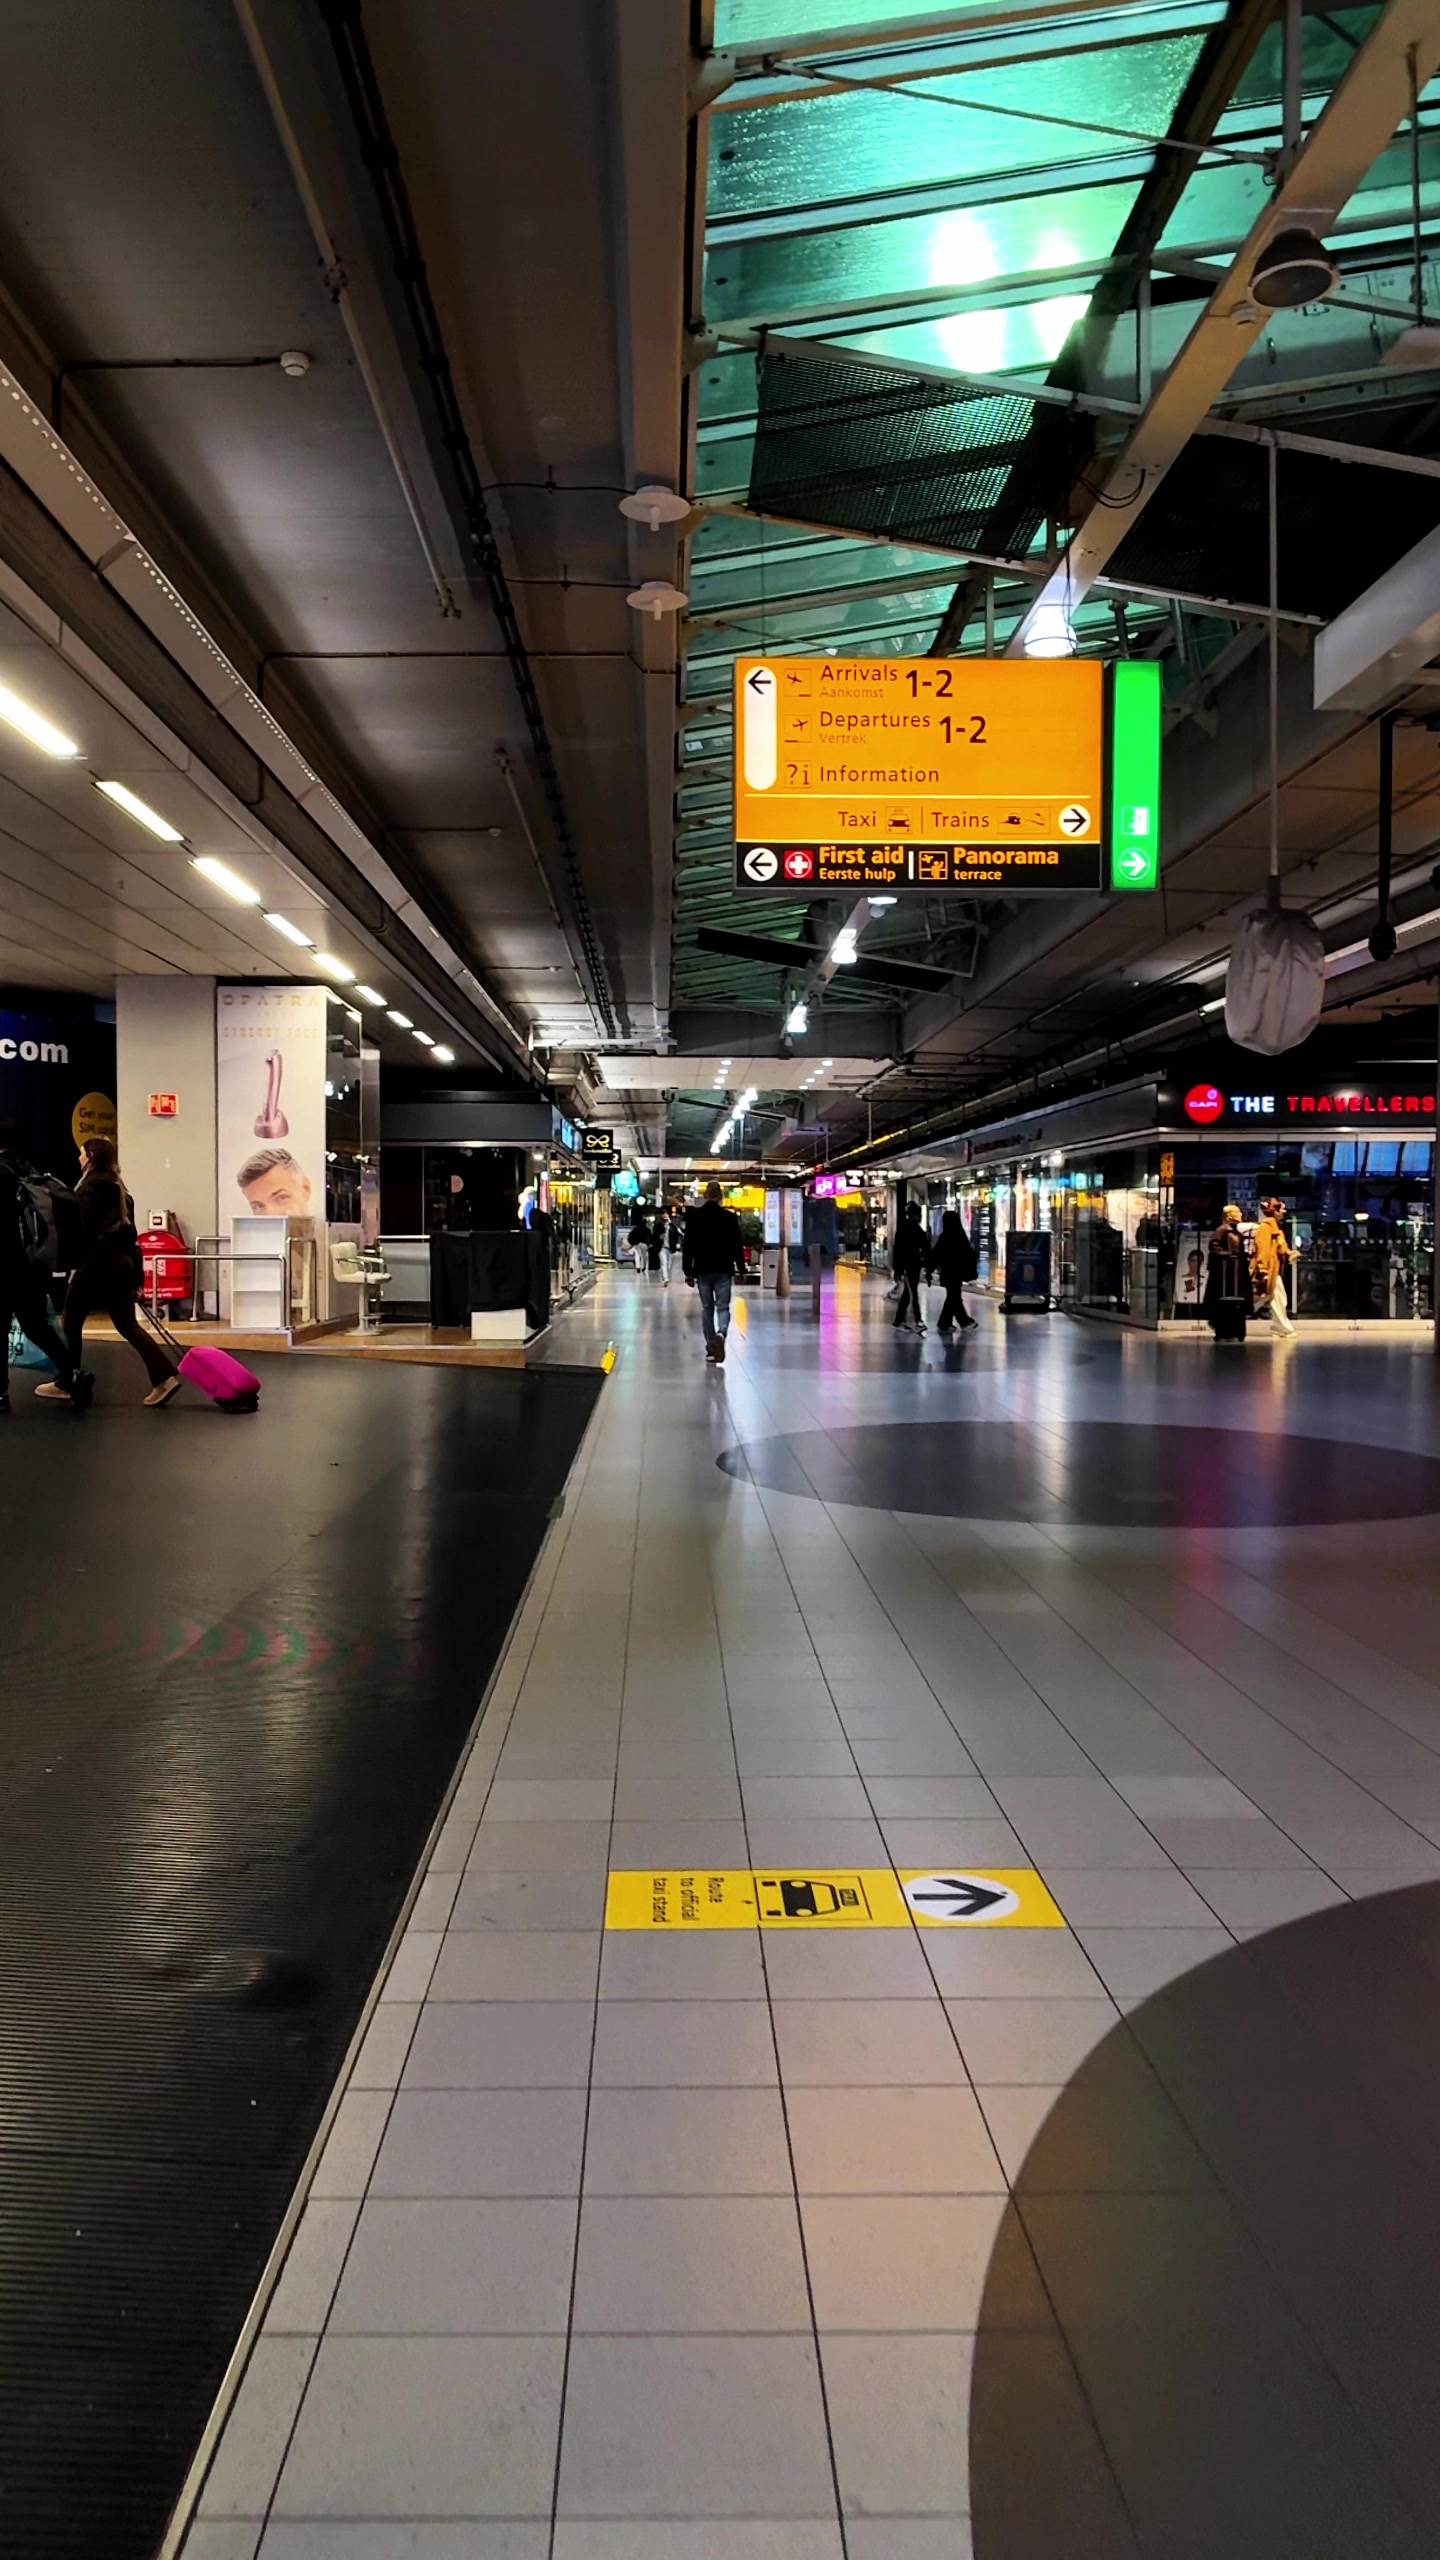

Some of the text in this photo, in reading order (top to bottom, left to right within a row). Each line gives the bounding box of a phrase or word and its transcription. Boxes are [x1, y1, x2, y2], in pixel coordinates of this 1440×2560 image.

[820, 664, 953, 698] Arrivals 1-2
[820, 687, 884, 698] Aankomst
[820, 711, 987, 744] Departures 1-2
[819, 733, 866, 744] Vertrek
[819, 765, 939, 782] Information
[838, 811, 877, 827] Taxi
[931, 811, 990, 828] Trains
[819, 846, 904, 864] First aid
[953, 847, 1059, 865] Panorama
[819, 868, 896, 882] Eerste hulp
[953, 870, 1002, 880] terrace
[223, 994, 319, 1006] OPATRA
[1230, 1096, 1436, 1113] THE TRAVELLERS
[707, 1876, 725, 1903] Route
[653, 1878, 672, 1923] taxi stand
[680, 1877, 700, 1921] to official
